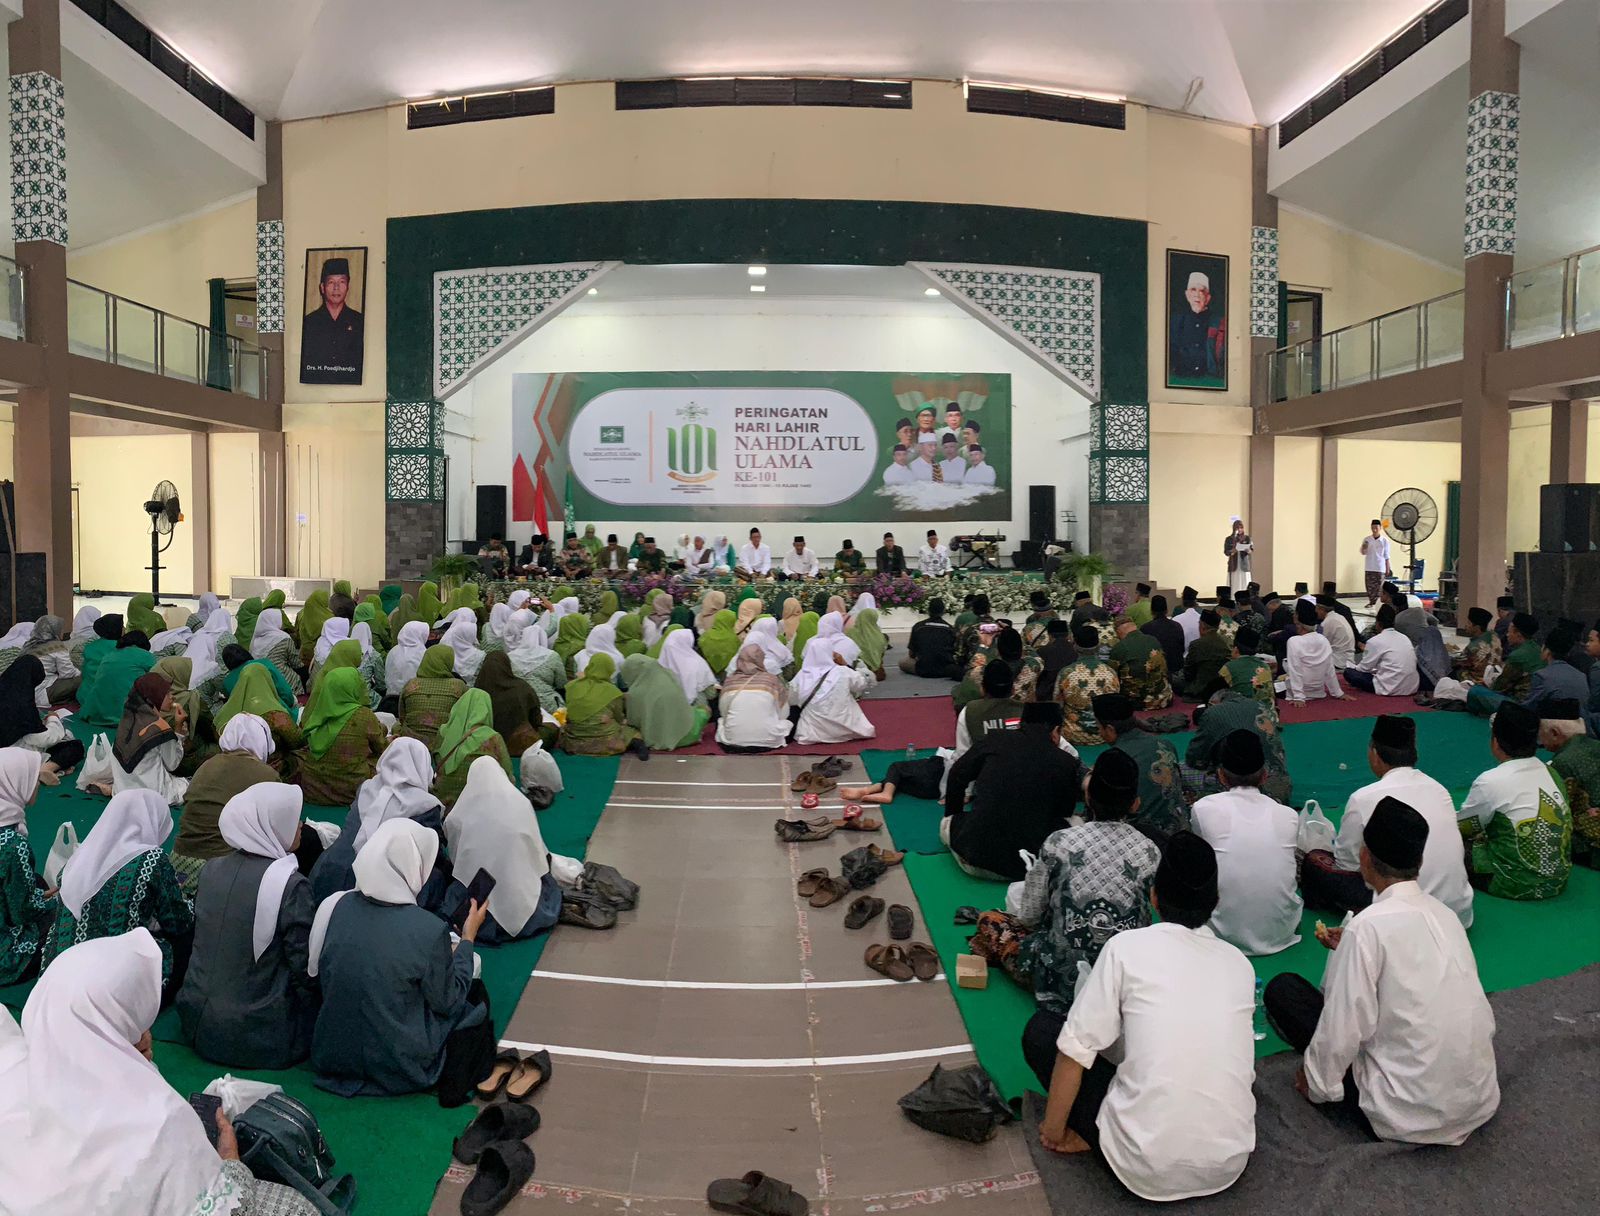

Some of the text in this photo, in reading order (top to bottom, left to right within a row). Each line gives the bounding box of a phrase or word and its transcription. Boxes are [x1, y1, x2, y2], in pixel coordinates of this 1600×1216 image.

[735, 407, 828, 418] PERINGATAN
[735, 422, 819, 433] HARI LAHIR
[735, 436, 865, 451] NAHDLATUL
[735, 454, 813, 469] ULAMA
[734, 471, 777, 482] KE-101
